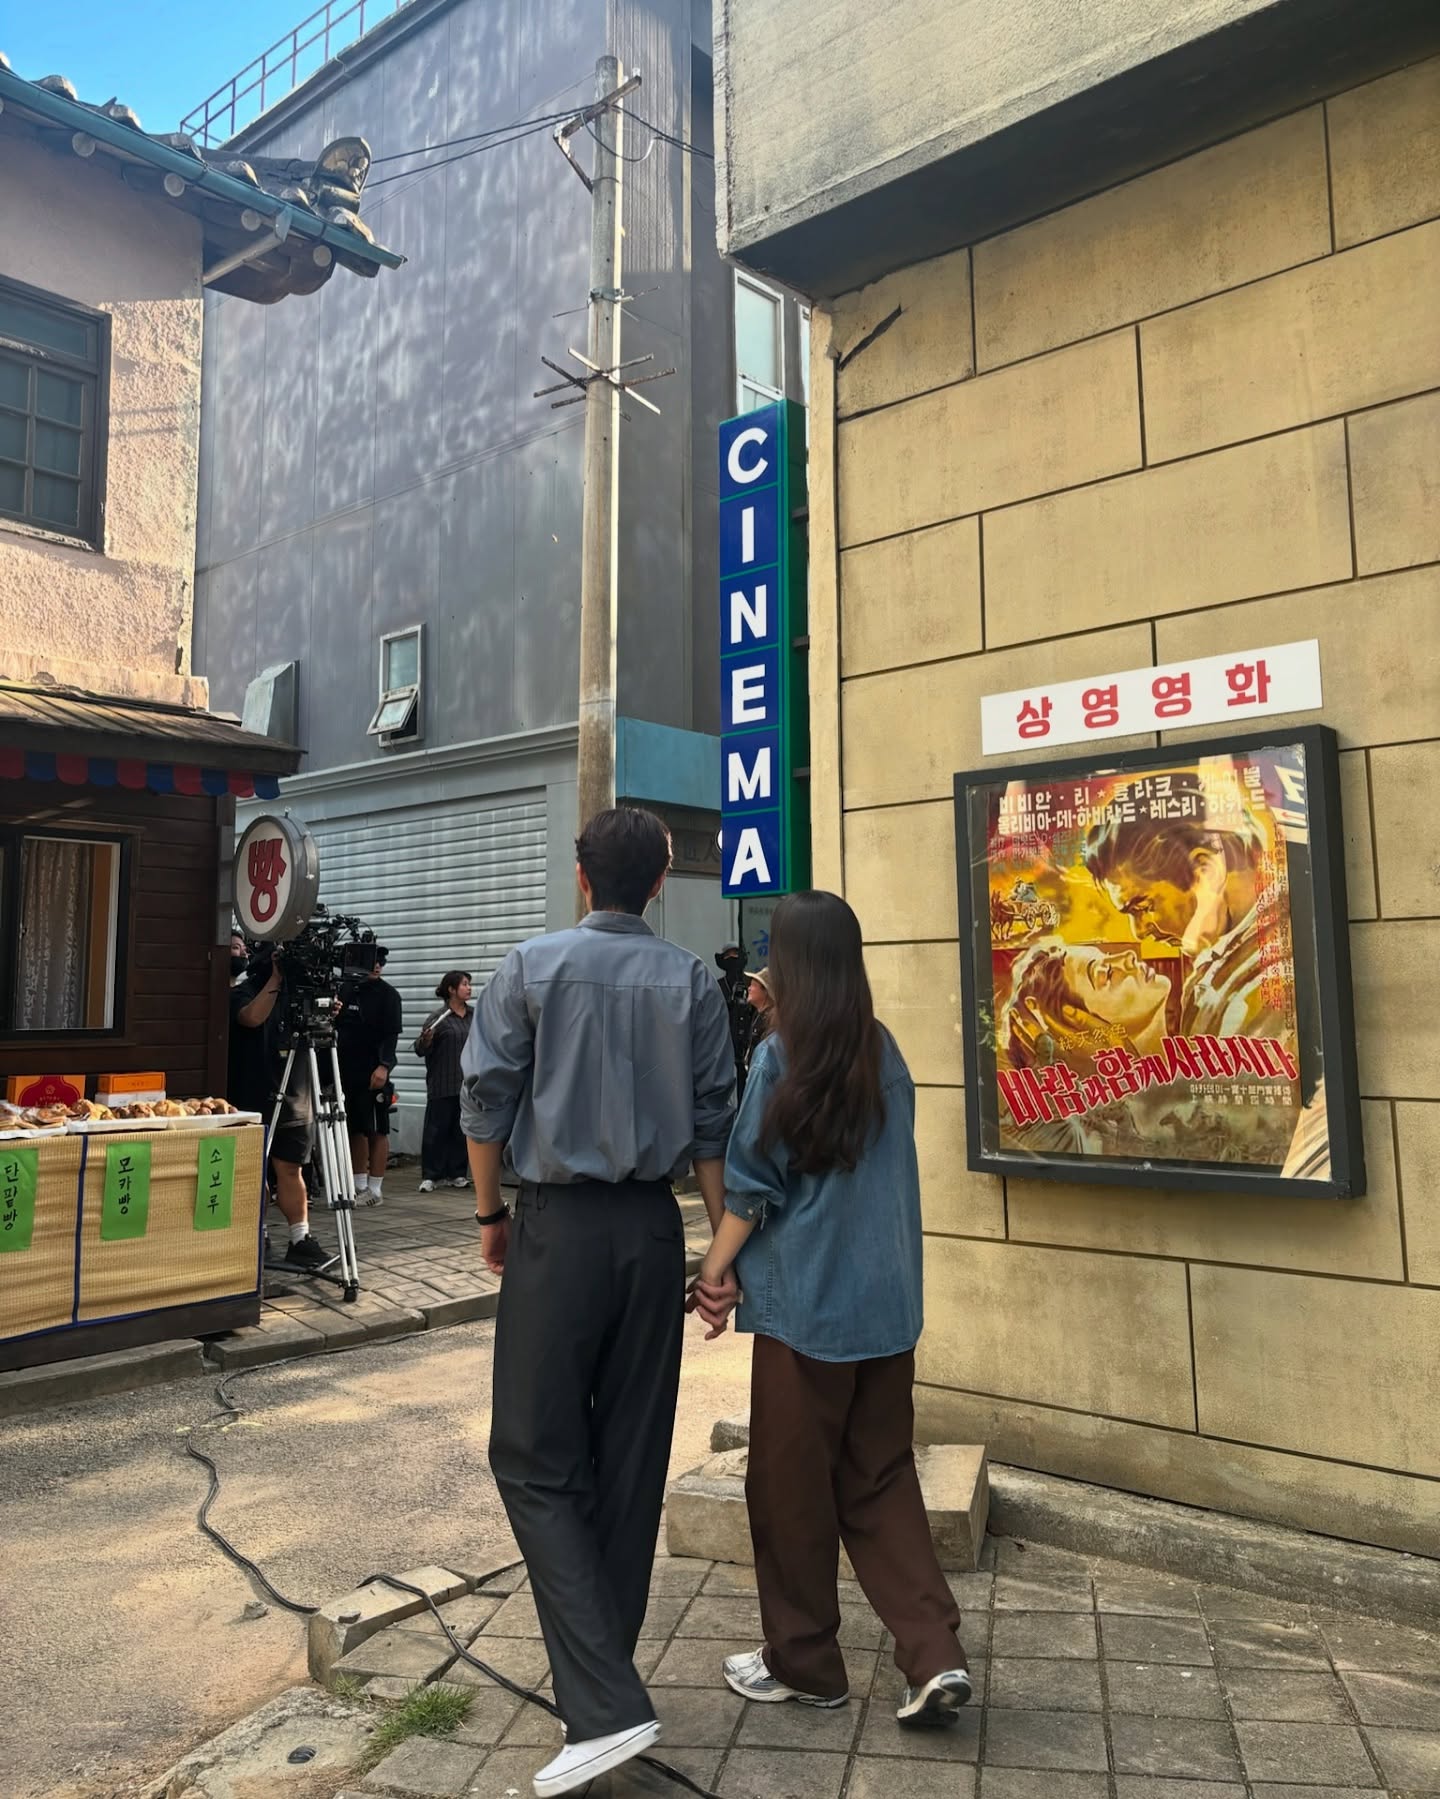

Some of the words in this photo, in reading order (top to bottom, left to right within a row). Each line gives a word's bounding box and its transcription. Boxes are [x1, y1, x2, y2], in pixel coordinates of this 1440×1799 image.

[727, 428, 771, 887] CINEMA
[247, 837, 288, 924] 빵
[997, 1060, 1111, 1127] 바람과
[1092, 1045, 1172, 1101] 함께
[1160, 1034, 1299, 1085] 사라지다
[3, 1162, 20, 1232] 단팥빵
[118, 1156, 135, 1215] 모카빵
[207, 1148, 223, 1216] 소보루
